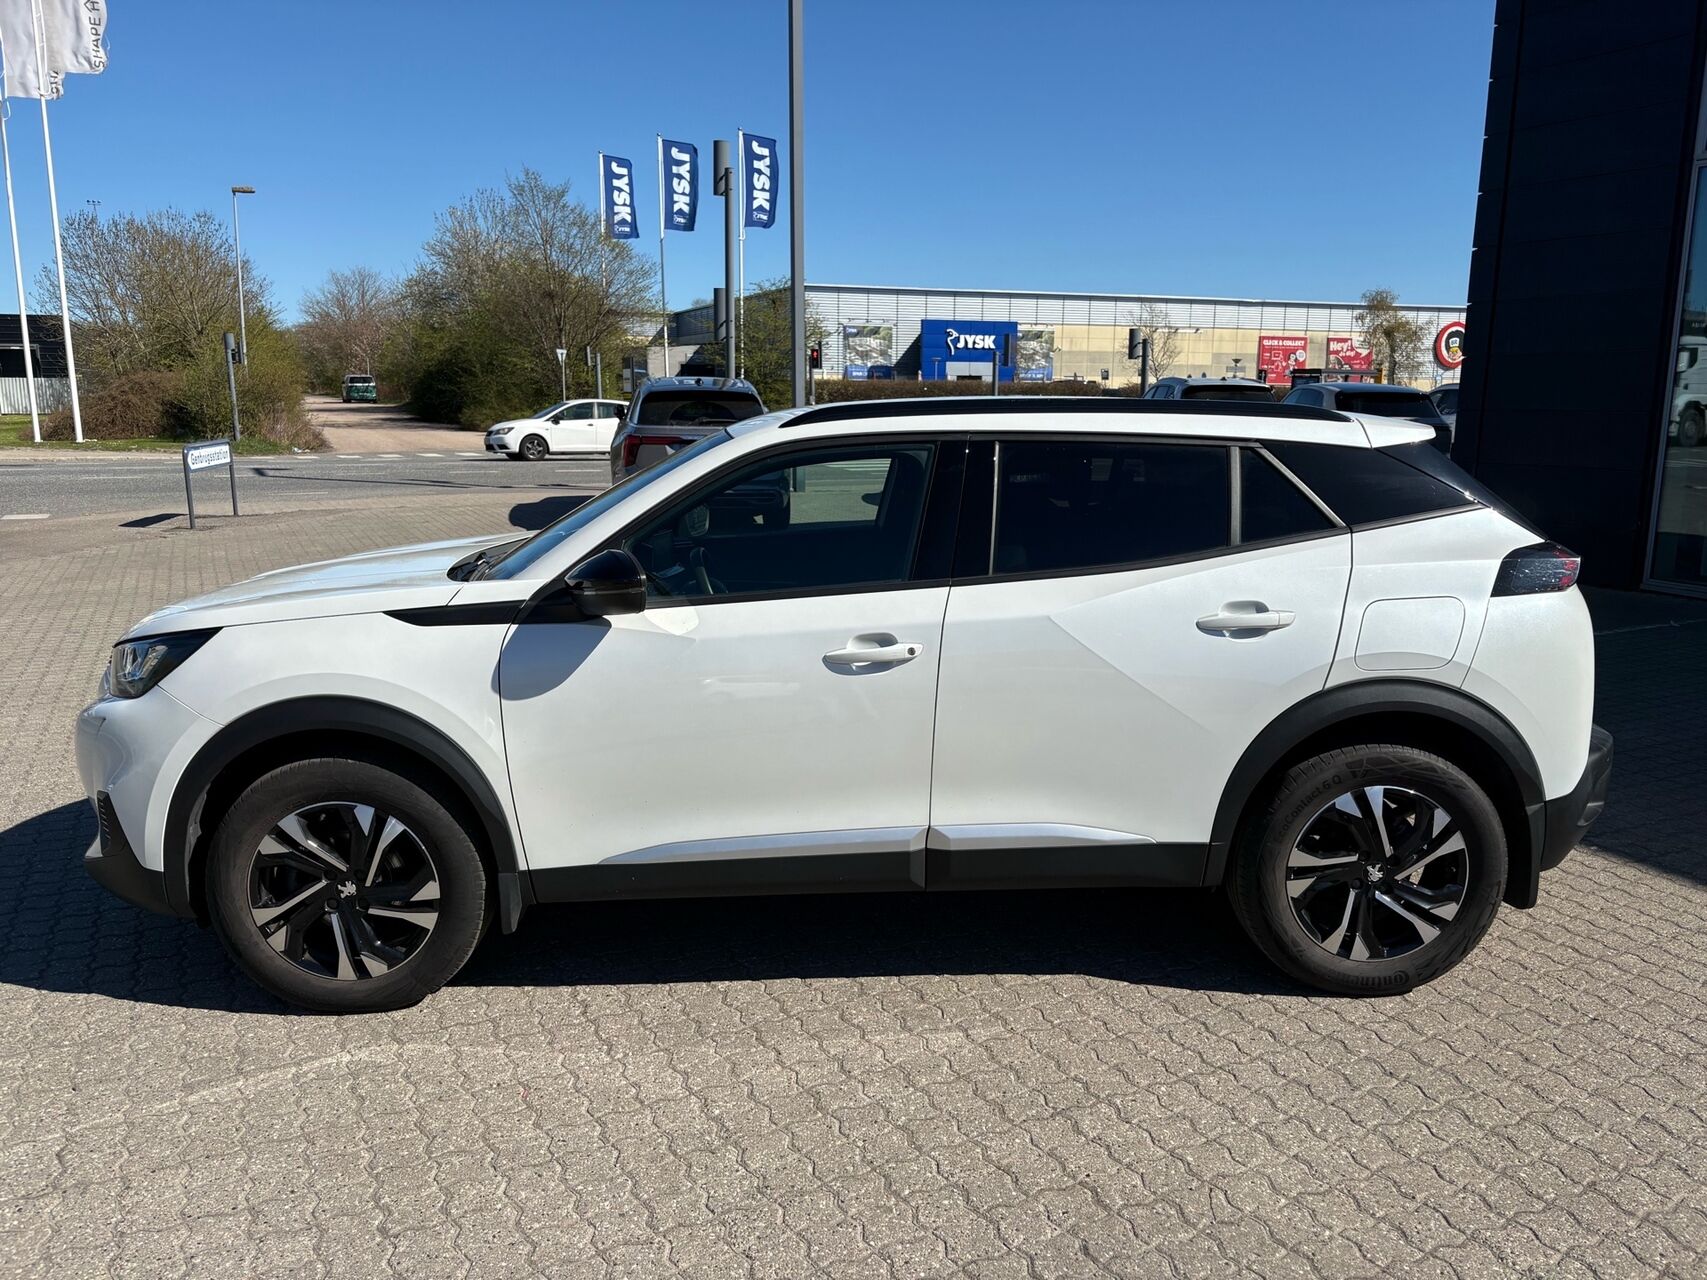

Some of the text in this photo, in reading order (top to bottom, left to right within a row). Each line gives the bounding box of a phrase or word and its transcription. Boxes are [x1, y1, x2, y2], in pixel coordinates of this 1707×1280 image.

[89, 16, 105, 69] SHAPE
[611, 160, 631, 223] JYSK
[670, 146, 690, 213] JYSK
[751, 140, 770, 210] JYSK
[957, 334, 996, 349] JYSK
